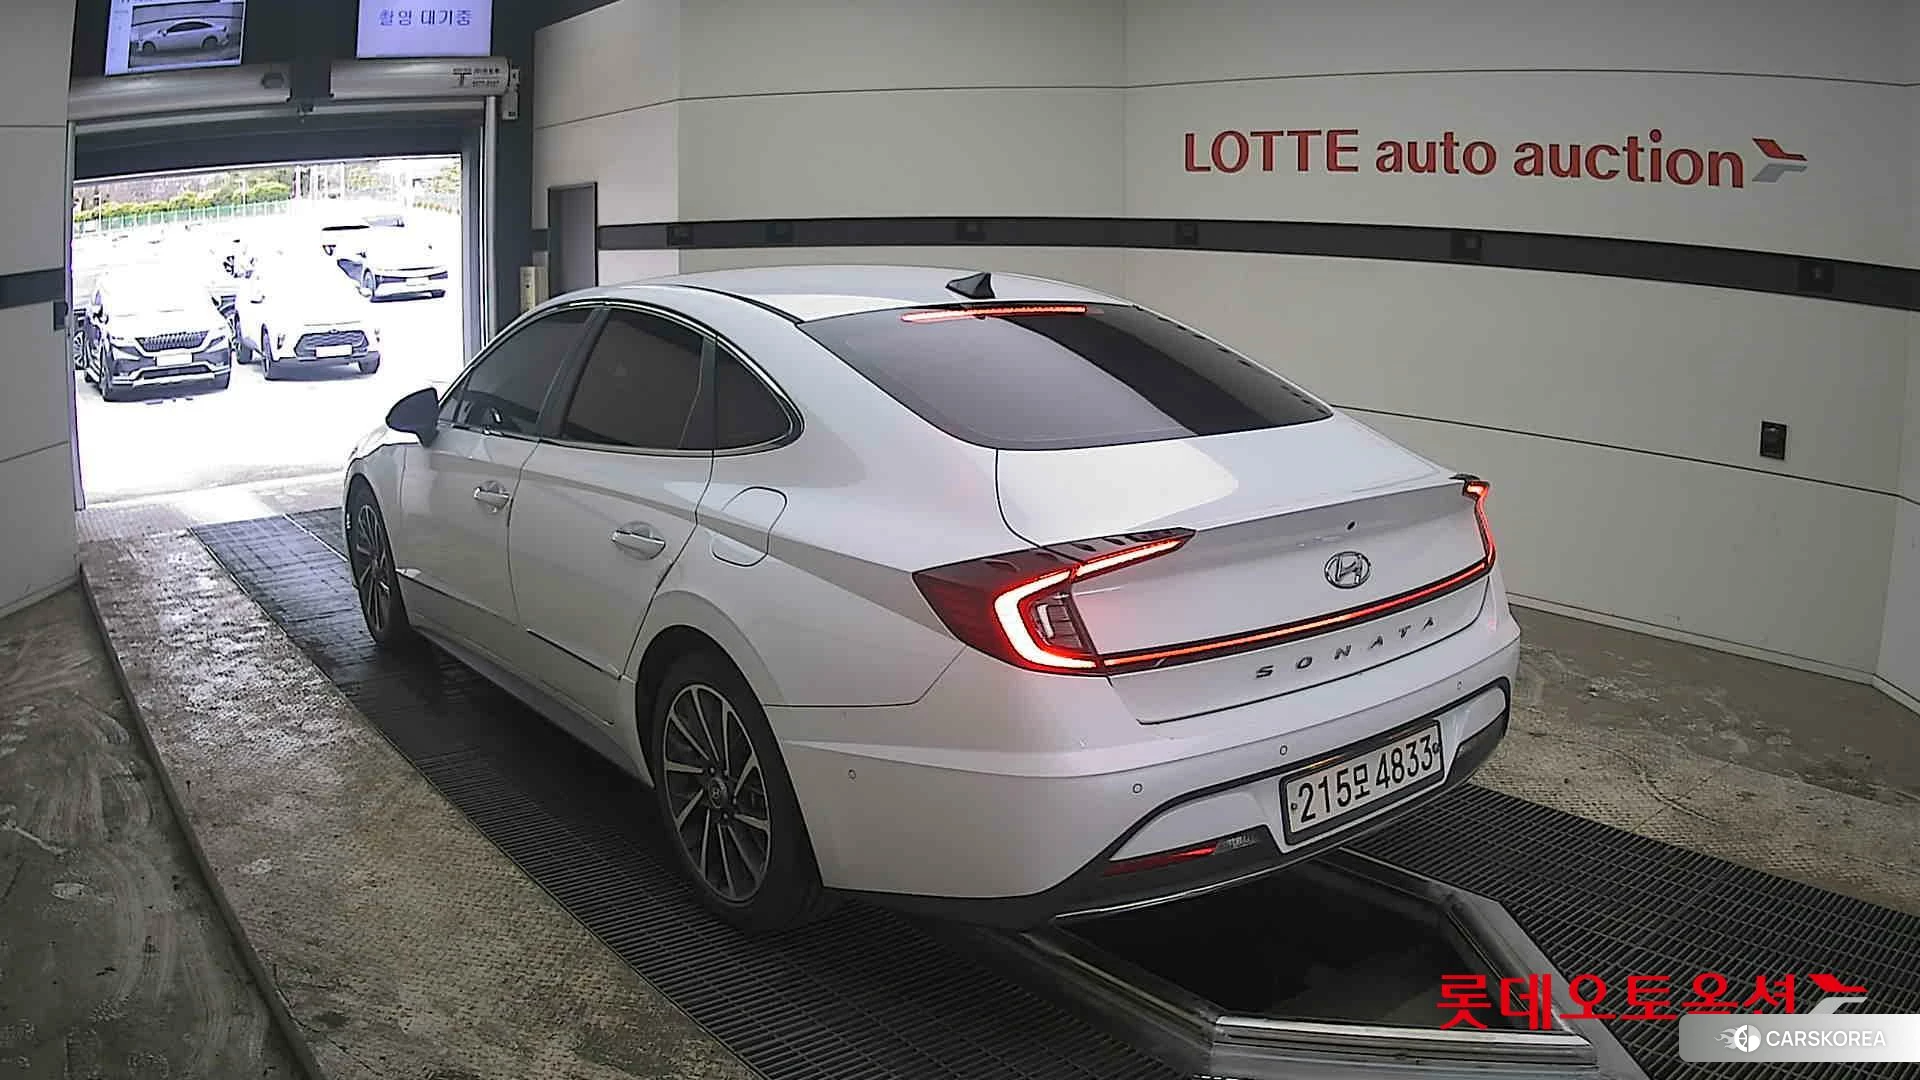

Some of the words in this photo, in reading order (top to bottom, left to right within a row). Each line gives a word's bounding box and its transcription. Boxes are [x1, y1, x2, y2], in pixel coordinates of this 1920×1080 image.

[421, 9, 472, 26] 대기중
[1184, 129, 1359, 173] LOTTE
[1376, 132, 1497, 175] auto
[1514, 129, 1745, 189] auction
[1255, 616, 1435, 679] SONATA
